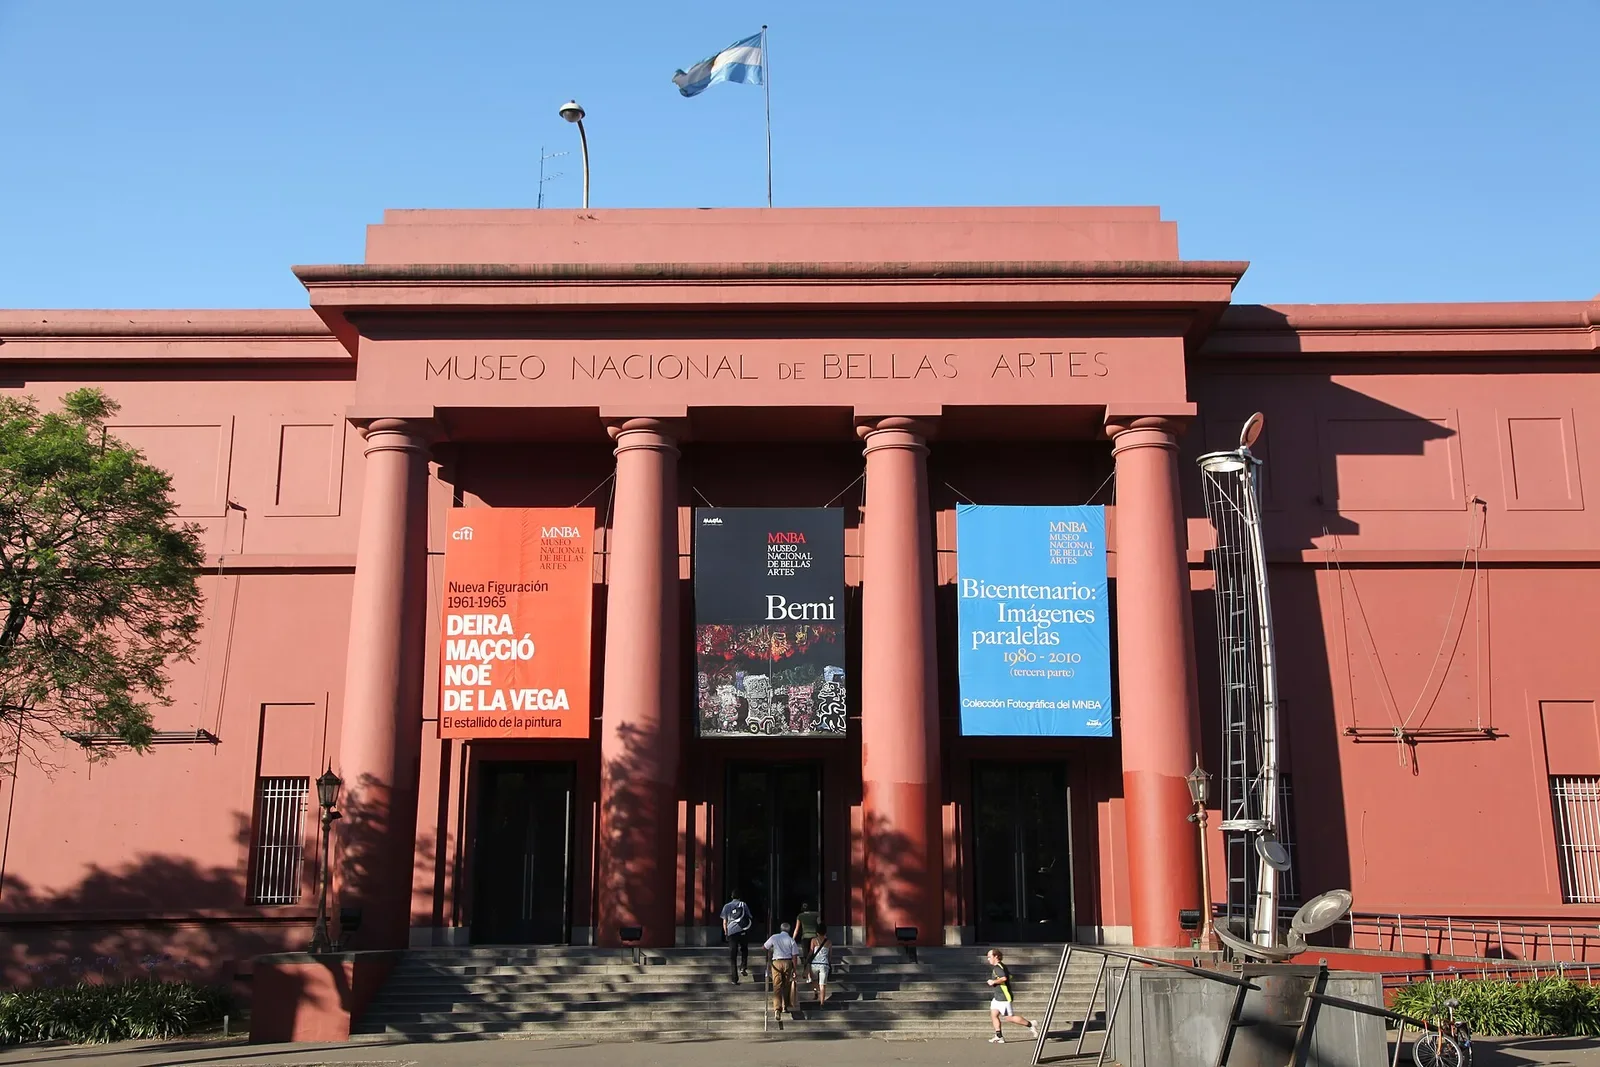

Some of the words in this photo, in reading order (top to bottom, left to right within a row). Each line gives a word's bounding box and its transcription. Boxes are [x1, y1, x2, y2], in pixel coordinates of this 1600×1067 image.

[425, 355, 546, 381] MUSEO
[571, 354, 759, 380] NACIONAL
[778, 362, 806, 380] DE
[823, 353, 959, 379] BELLAS
[991, 352, 1109, 379] ARTES
[452, 527, 473, 540] citi
[541, 527, 581, 538] MNBA
[1050, 522, 1087, 532] MNBA
[768, 532, 806, 544] MNBA
[449, 581, 485, 593] Nueva
[488, 580, 548, 595] Figuración
[962, 578, 1096, 600] Bicentenario:
[448, 596, 506, 608] 1961-1965
[765, 594, 835, 620] Berni
[998, 603, 1095, 628] Imágenes
[447, 614, 513, 636] DEIRA
[446, 633, 535, 661] MACCIÓ
[972, 626, 1060, 650] paralelas
[1003, 648, 1036, 666] 1980
[1049, 653, 1081, 663] 2010
[445, 659, 492, 686] NOÉ
[1010, 668, 1045, 678] (tercera
[1047, 668, 1075, 679] parte)
[444, 690, 474, 712] DE
[478, 689, 507, 711] LA
[510, 689, 569, 710] VEGA
[962, 699, 1005, 708] Colección
[1007, 699, 1055, 710] Fotográfica
[1057, 700, 1070, 709] del
[1072, 700, 1102, 709] MNBA
[443, 717, 452, 728] El
[454, 717, 496, 728] estallido
[499, 717, 512, 727] de
[514, 717, 522, 727] la
[525, 717, 561, 730] pintura
